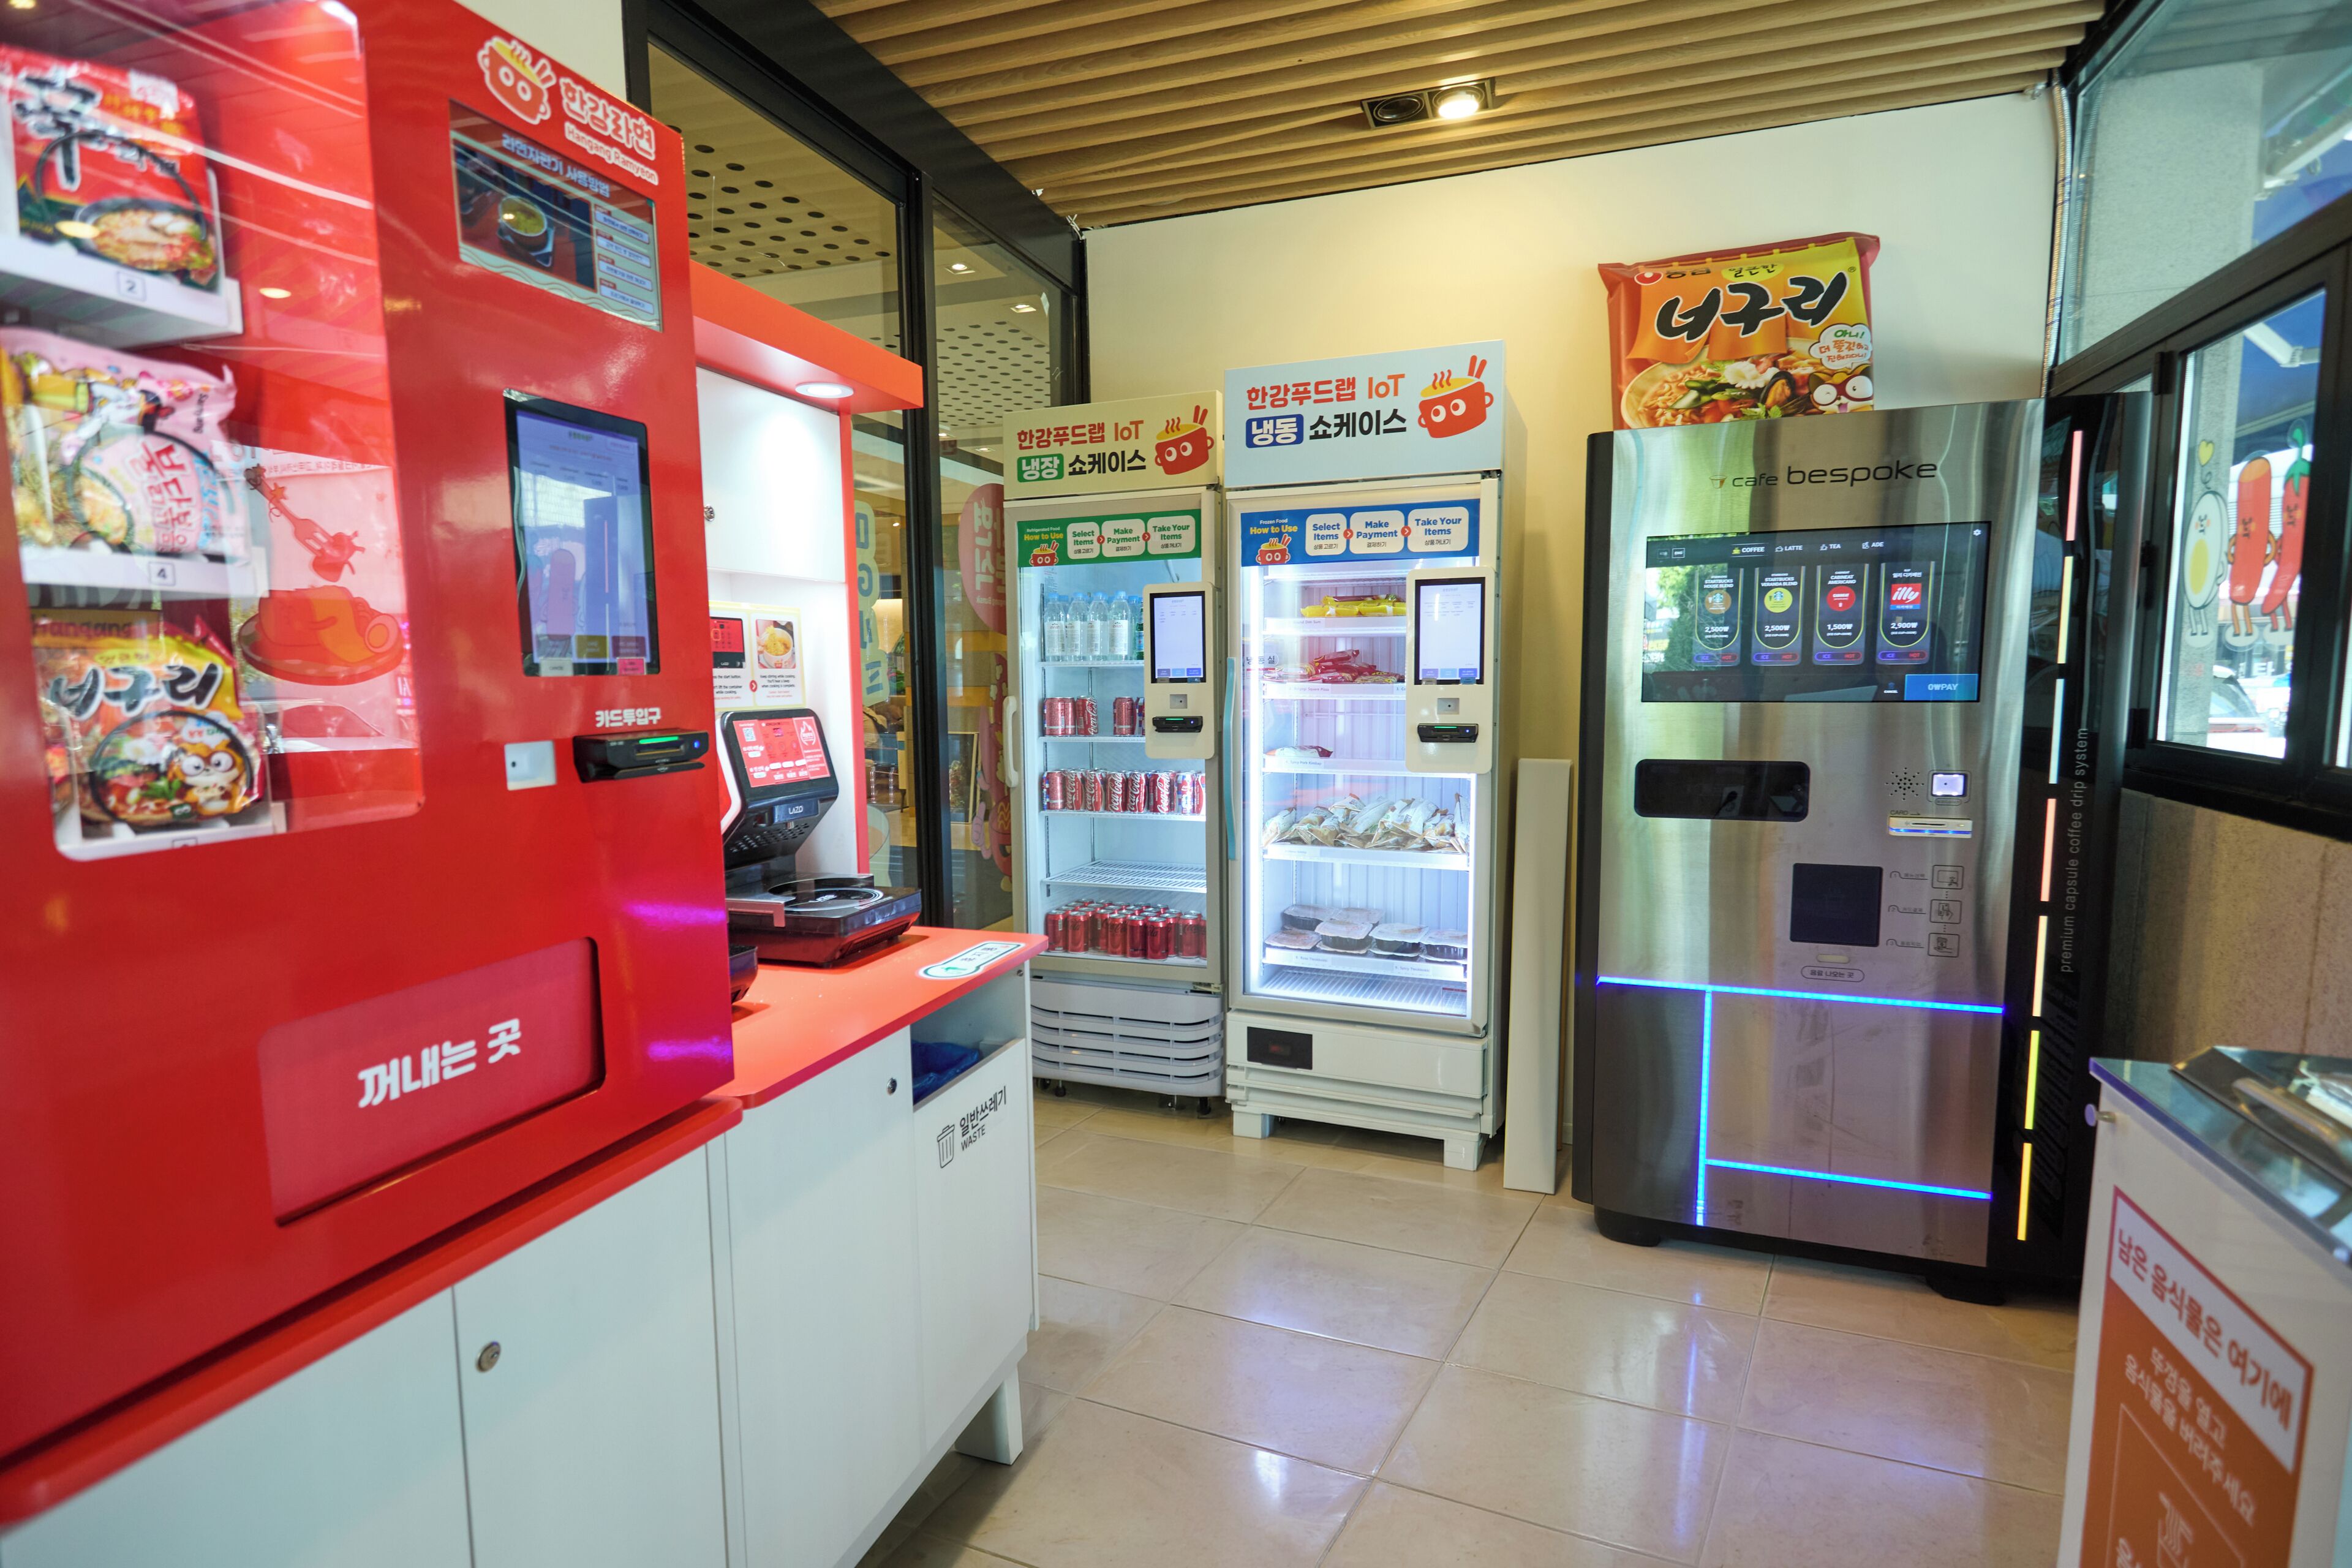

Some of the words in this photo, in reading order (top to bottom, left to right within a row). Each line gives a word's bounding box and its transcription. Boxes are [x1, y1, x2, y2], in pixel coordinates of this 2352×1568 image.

[559, 78, 655, 160] 한강라면
[566, 126, 612, 162] Hangang
[614, 148, 658, 184] Ramyeon
[126, 280, 137, 293] 2
[1655, 271, 1849, 342] 너구리
[1834, 330, 1865, 339] 아니!
[1819, 345, 1830, 354] 더
[1246, 377, 1356, 410] 한강푸드랩
[1368, 374, 1405, 399] IoT
[1017, 422, 1105, 450] 한강푸드랩
[1114, 420, 1144, 441] IoT
[1251, 417, 1298, 445] 냉동
[1309, 409, 1406, 440] 쇼케이스
[1022, 456, 1060, 480] 냉장
[1068, 450, 1146, 475] 쇼케이스
[1732, 473, 1778, 487] cafe
[1787, 460, 1937, 487] bespoke
[1313, 522, 1340, 531] Select
[1356, 529, 1398, 540] Payment
[1365, 520, 1389, 529] Make
[1415, 518, 1439, 526] Take
[1440, 517, 1462, 526] Your
[1425, 527, 1452, 536] Items
[1107, 535, 1140, 545] Payment
[1313, 532, 1339, 541] Items
[157, 568, 167, 579] 4
[1892, 587, 1920, 603] illy
[48, 662, 222, 721] 너구리
[595, 707, 662, 727] 카드투입구
[2075, 727, 2089, 777] system
[2070, 780, 2086, 807] drip
[788, 805, 804, 815] LAZO
[2068, 812, 2082, 854] coffee
[2064, 859, 2080, 911] capsule
[2060, 916, 2075, 973] premium
[358, 1040, 477, 1108] 꺼내는
[488, 1018, 522, 1064] 곳
[960, 1085, 1006, 1137] 일반쓰레기
[961, 1125, 985, 1152] WASTE
[2118, 1227, 2148, 1282] 남은
[2151, 1264, 2223, 1359] 음식물은
[2227, 1338, 2293, 1431] 여기에
[2195, 1396, 2226, 1450] 열고
[2124, 1354, 2177, 1432] 음식물을
[2179, 1417, 2256, 1528] 버려주세요
